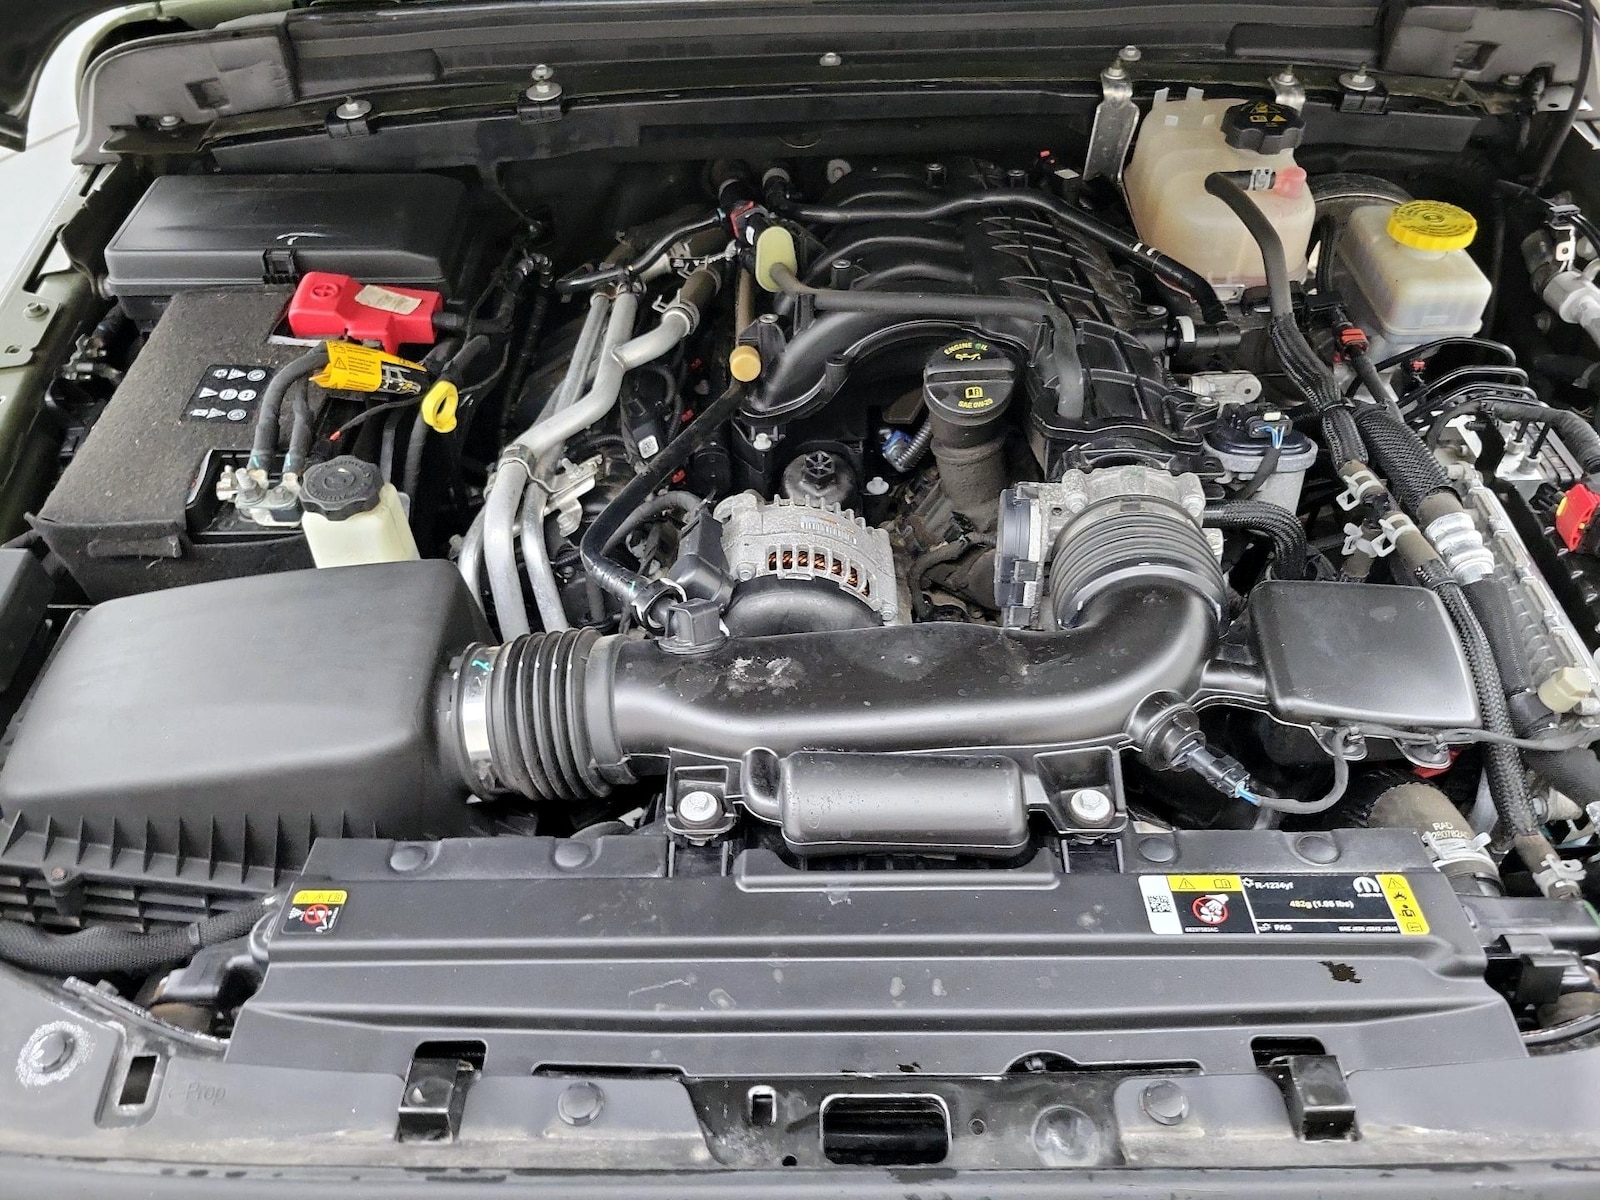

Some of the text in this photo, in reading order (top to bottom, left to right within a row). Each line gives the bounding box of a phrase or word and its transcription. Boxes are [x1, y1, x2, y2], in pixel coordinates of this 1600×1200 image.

[943, 342, 988, 355] ENGINE OIL
[958, 400, 973, 408] SAE
[1432, 821, 1453, 830] RAD
[1254, 881, 1293, 891] R-1234yf
[1335, 899, 1355, 909] lbs)
[1273, 923, 1293, 931] PAG
[185, 1080, 227, 1106] Prop
